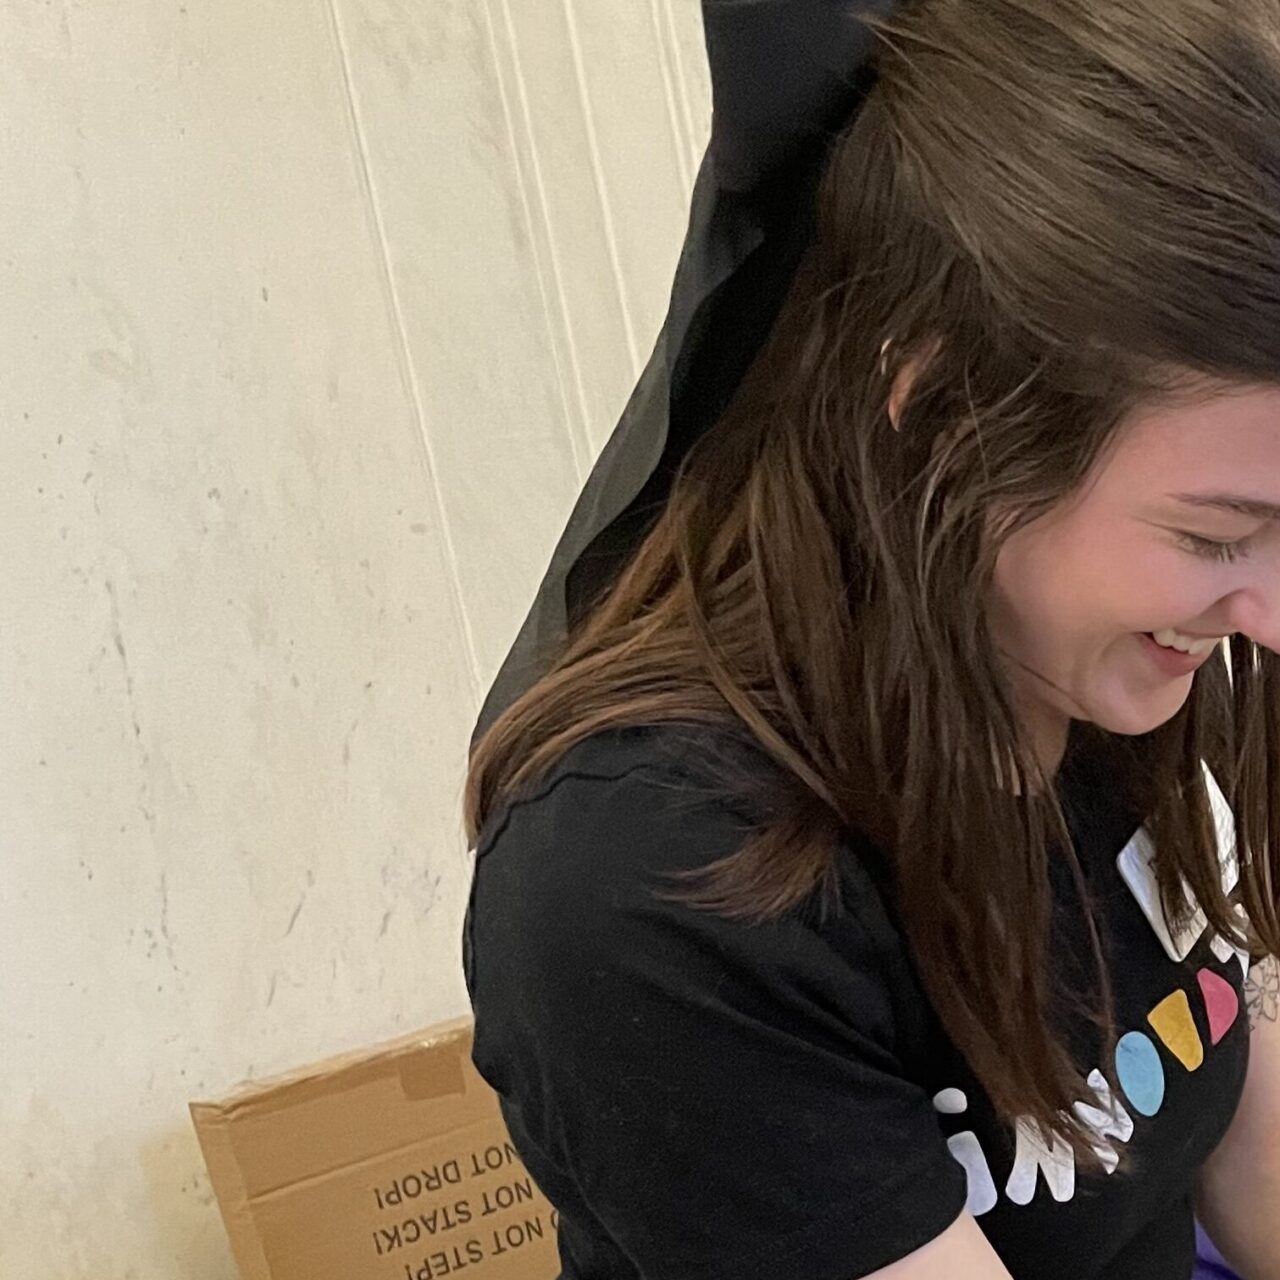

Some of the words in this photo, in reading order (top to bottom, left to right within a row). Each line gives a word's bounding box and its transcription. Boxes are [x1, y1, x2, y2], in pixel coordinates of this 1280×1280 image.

[471, 1142, 521, 1178] NOT
[374, 1160, 462, 1210] DROP!
[480, 1178, 533, 1217] NOT
[372, 1200, 472, 1255] STACK!
[492, 1216, 543, 1256] NOT
